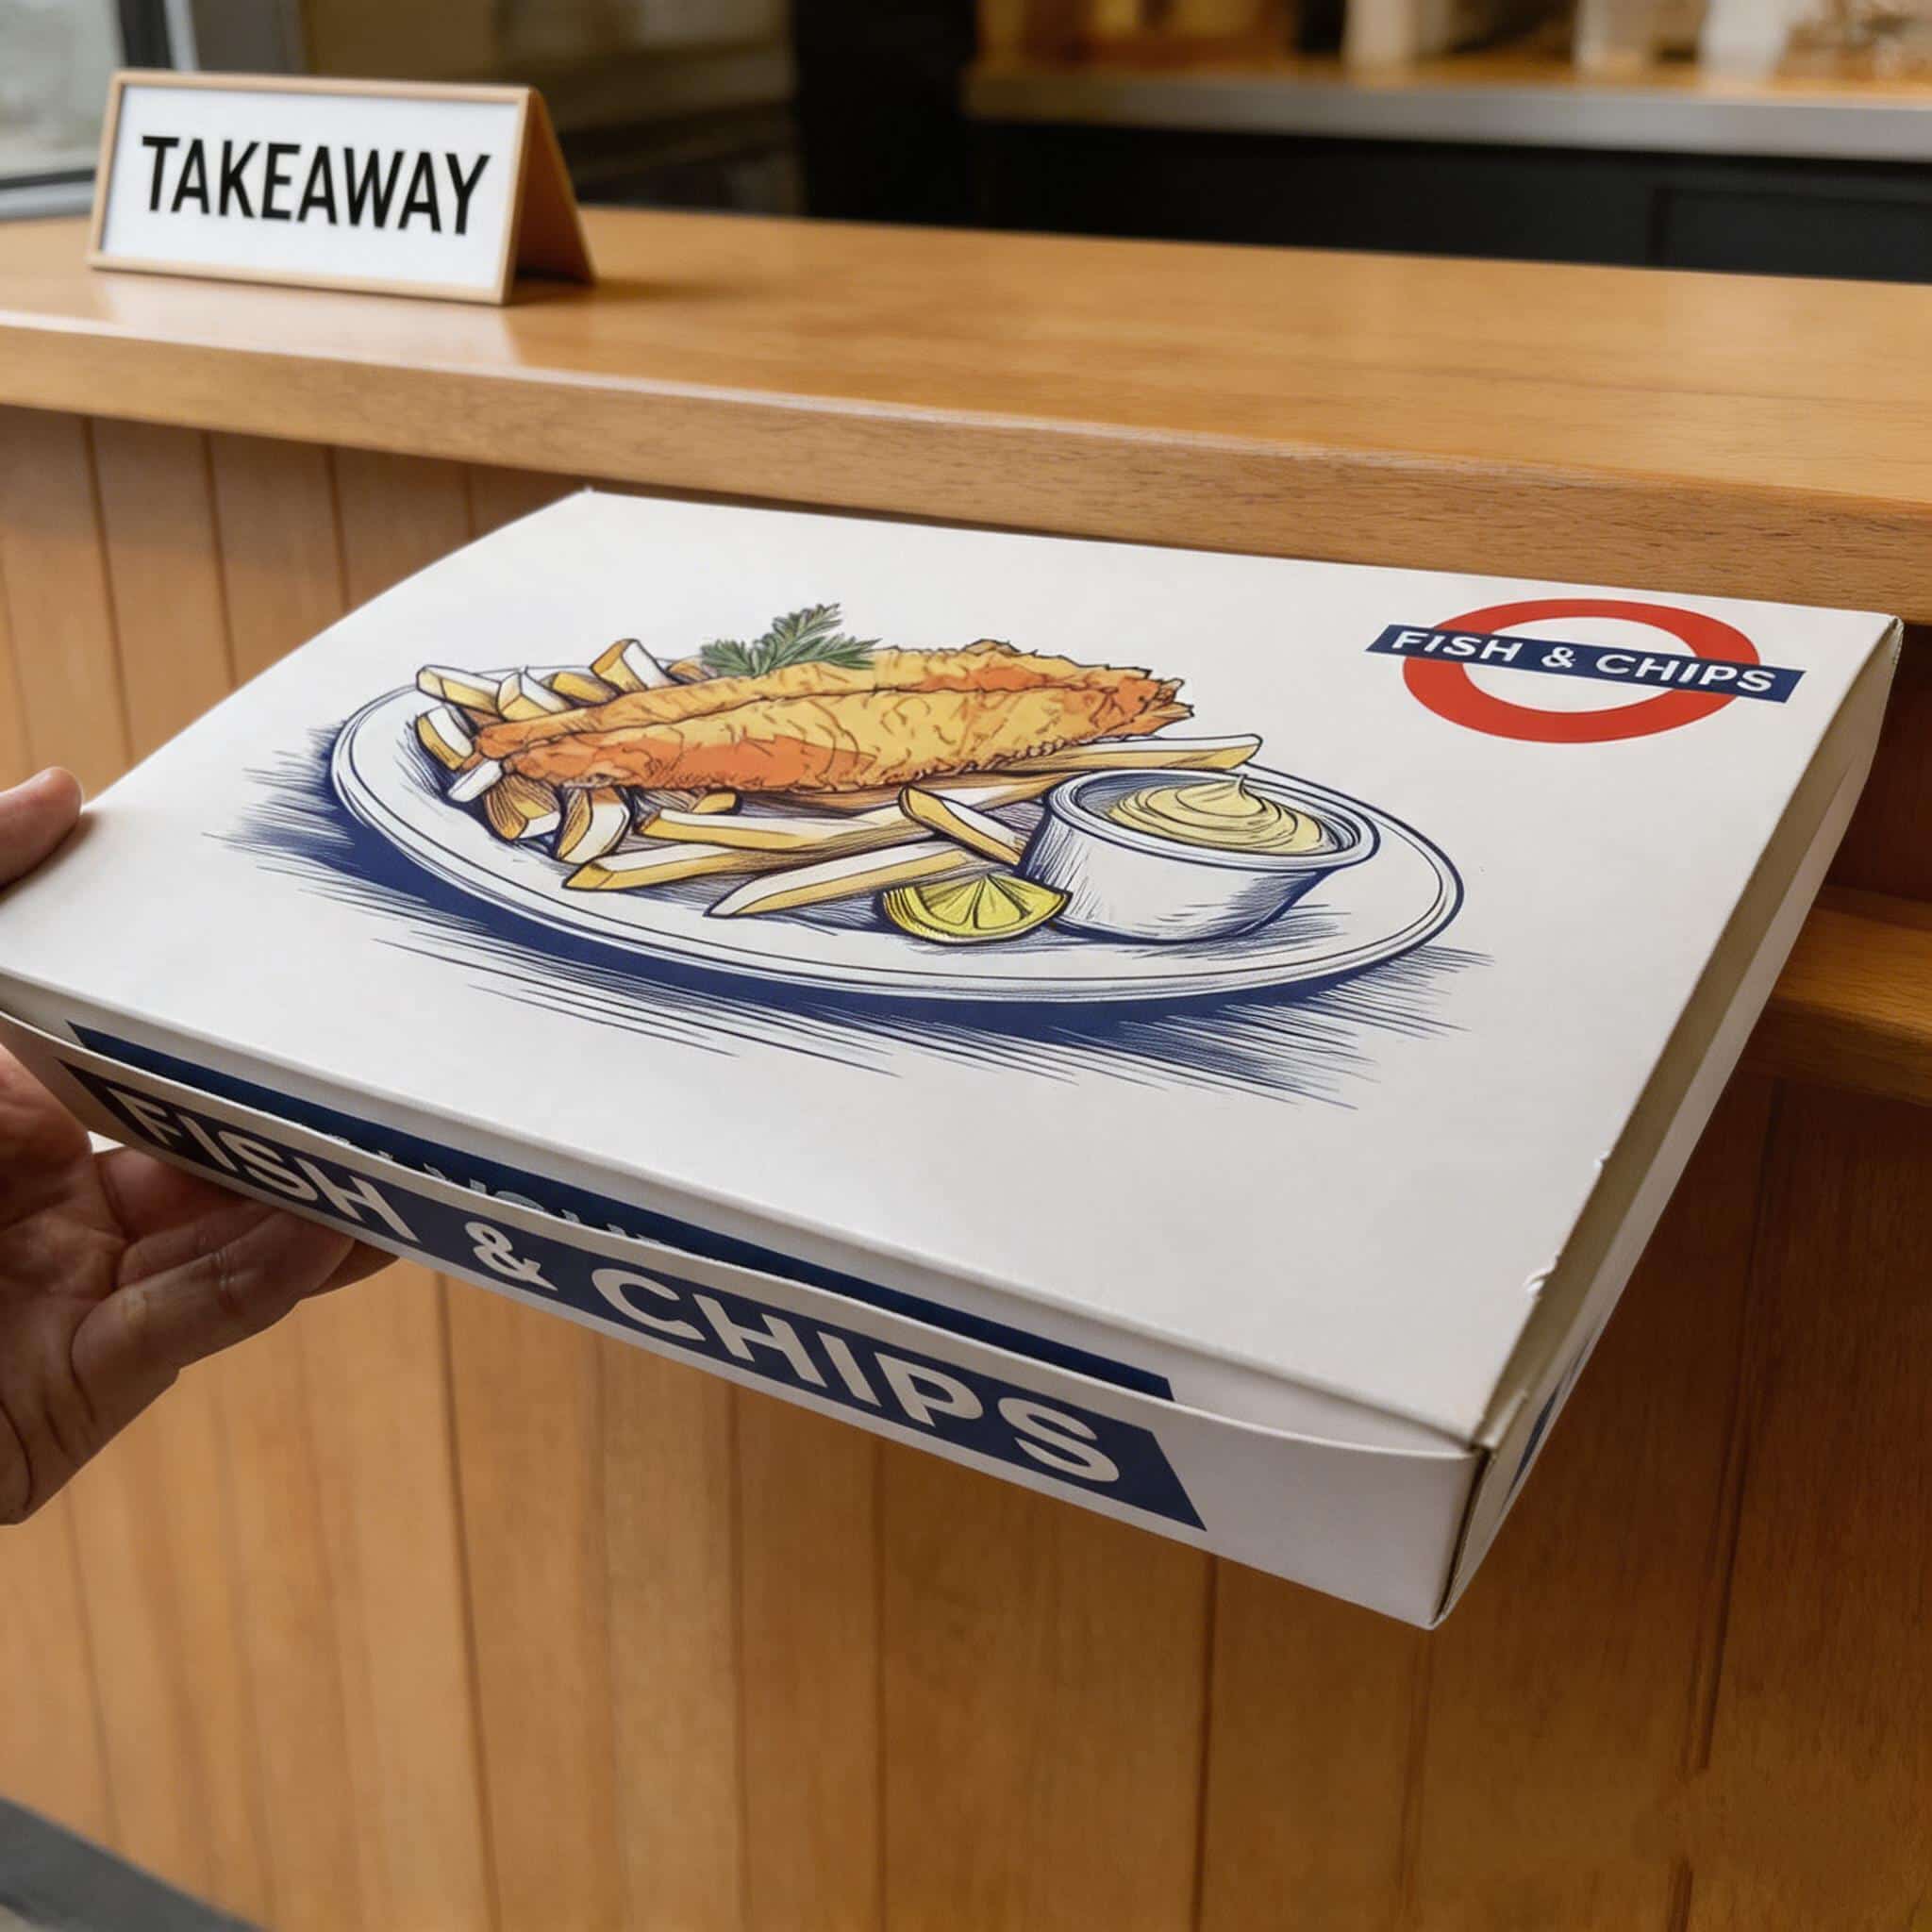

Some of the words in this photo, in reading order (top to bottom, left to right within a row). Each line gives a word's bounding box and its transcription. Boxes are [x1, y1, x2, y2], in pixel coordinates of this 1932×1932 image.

[142, 135, 491, 235] TAKEAWAY
[1391, 630, 1524, 661] FISH
[1541, 646, 1576, 668] &
[1596, 654, 1776, 692] CHIPS
[105, 1087, 419, 1242] FISH
[465, 1223, 558, 1291] &
[591, 1268, 1120, 1482] CHIPS
